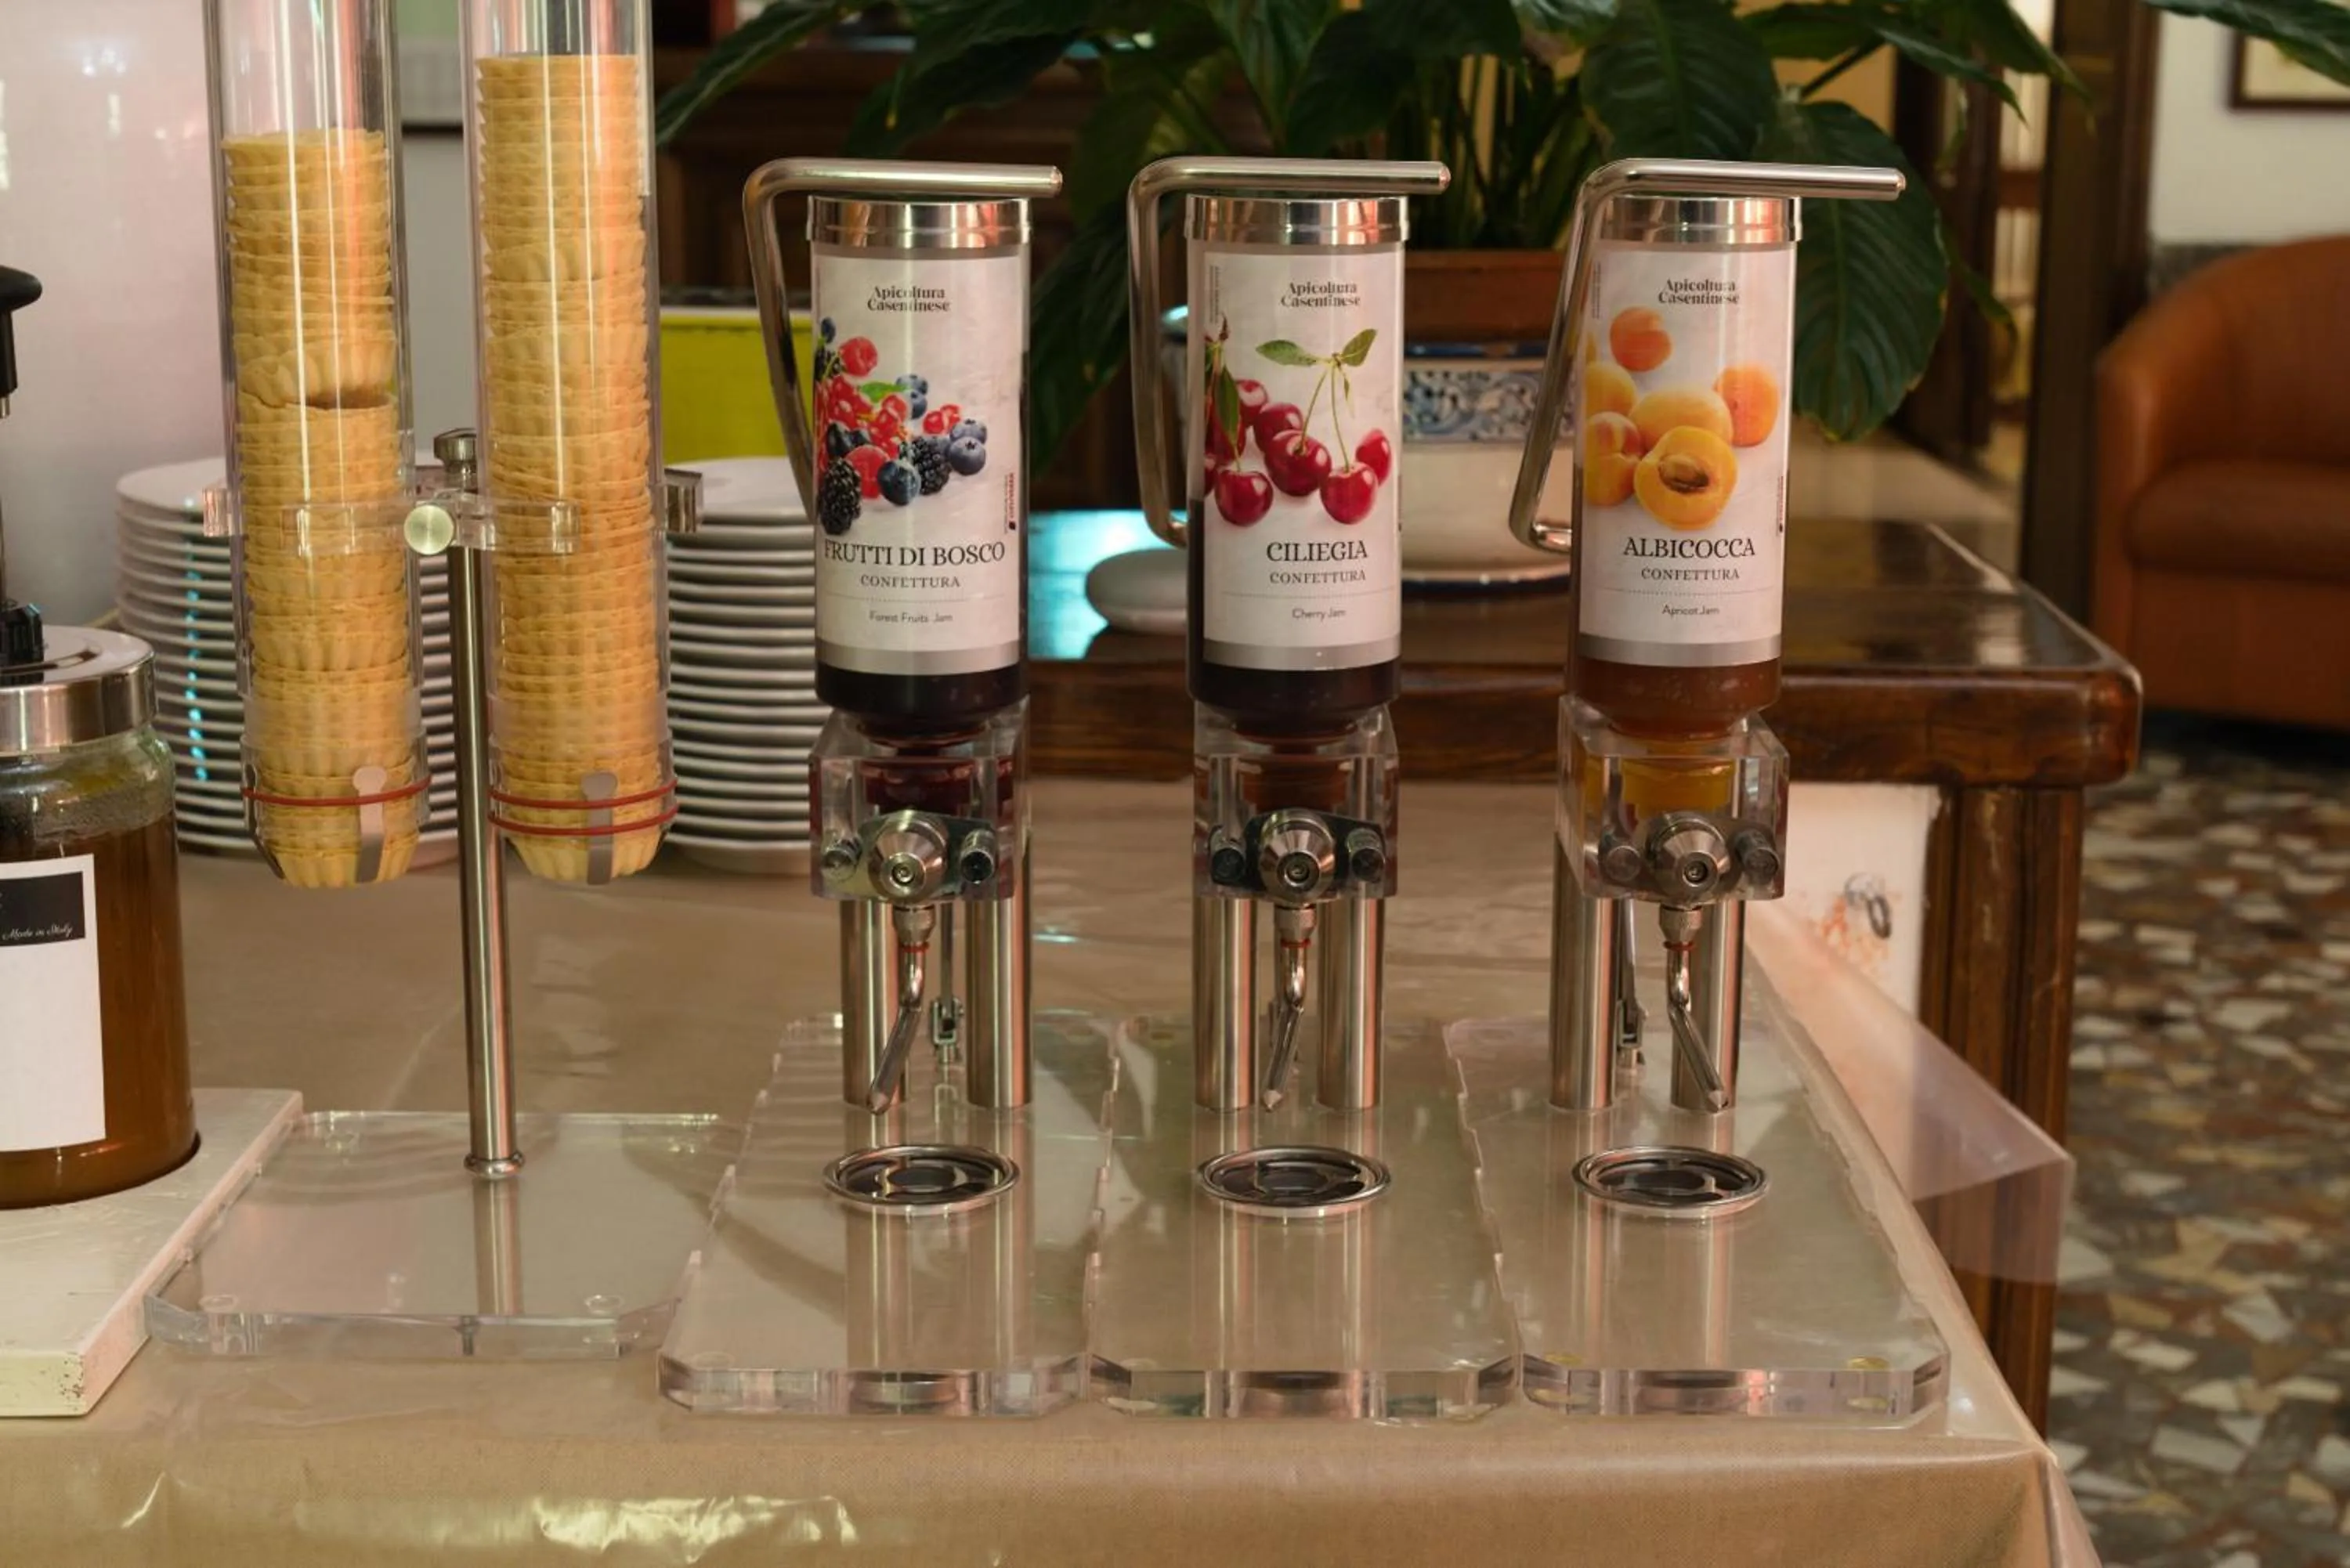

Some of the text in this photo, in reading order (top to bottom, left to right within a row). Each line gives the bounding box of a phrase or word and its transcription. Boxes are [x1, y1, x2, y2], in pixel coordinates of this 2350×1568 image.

[1286, 281, 1357, 296] Apicoltura
[1663, 278, 1736, 293] Apicoltua
[1658, 291, 1739, 305] Casentinse
[824, 539, 1005, 565] FRUTTI DI BOSCO
[1266, 540, 1368, 562] CILIEGIA
[1623, 537, 1755, 558] ALBICOCCA
[861, 574, 960, 588] CONFETTURA
[1270, 569, 1366, 584] CONFETTURA
[1641, 567, 1740, 580] CONFETTURA
[870, 611, 953, 623] Forest Fruits Jam
[1292, 607, 1346, 622] Cherry Jam
[1661, 604, 1719, 617] Apricot Jam
[2, 928, 33, 940] Made
[46, 922, 73, 938] Italy
